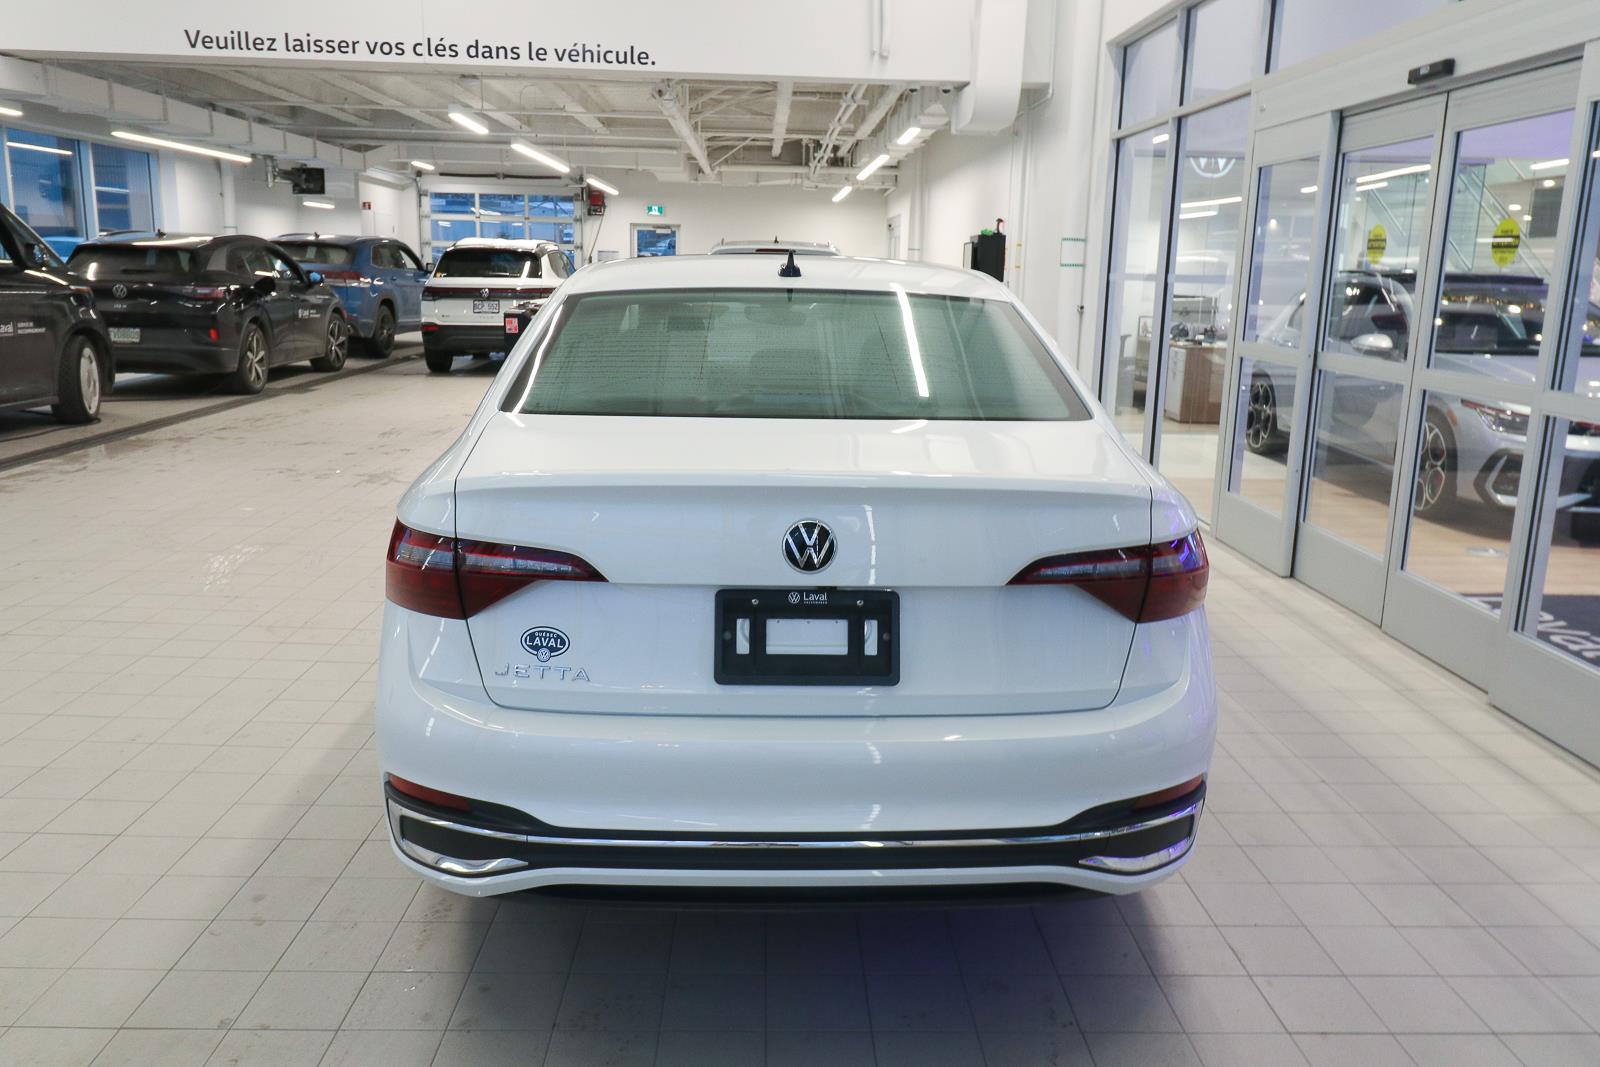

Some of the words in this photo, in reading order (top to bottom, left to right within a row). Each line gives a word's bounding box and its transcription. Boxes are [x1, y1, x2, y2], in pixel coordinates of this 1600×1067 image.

[184, 29, 278, 52] Veuillez
[284, 33, 360, 54] laisser
[366, 40, 406, 56] vos
[412, 37, 460, 58] clés
[466, 39, 521, 60] dans
[528, 41, 548, 62] le
[554, 42, 657, 66] véhicule.
[803, 591, 828, 601] Laval
[526, 636, 564, 649] LAVAL
[494, 663, 591, 682] JETTA
